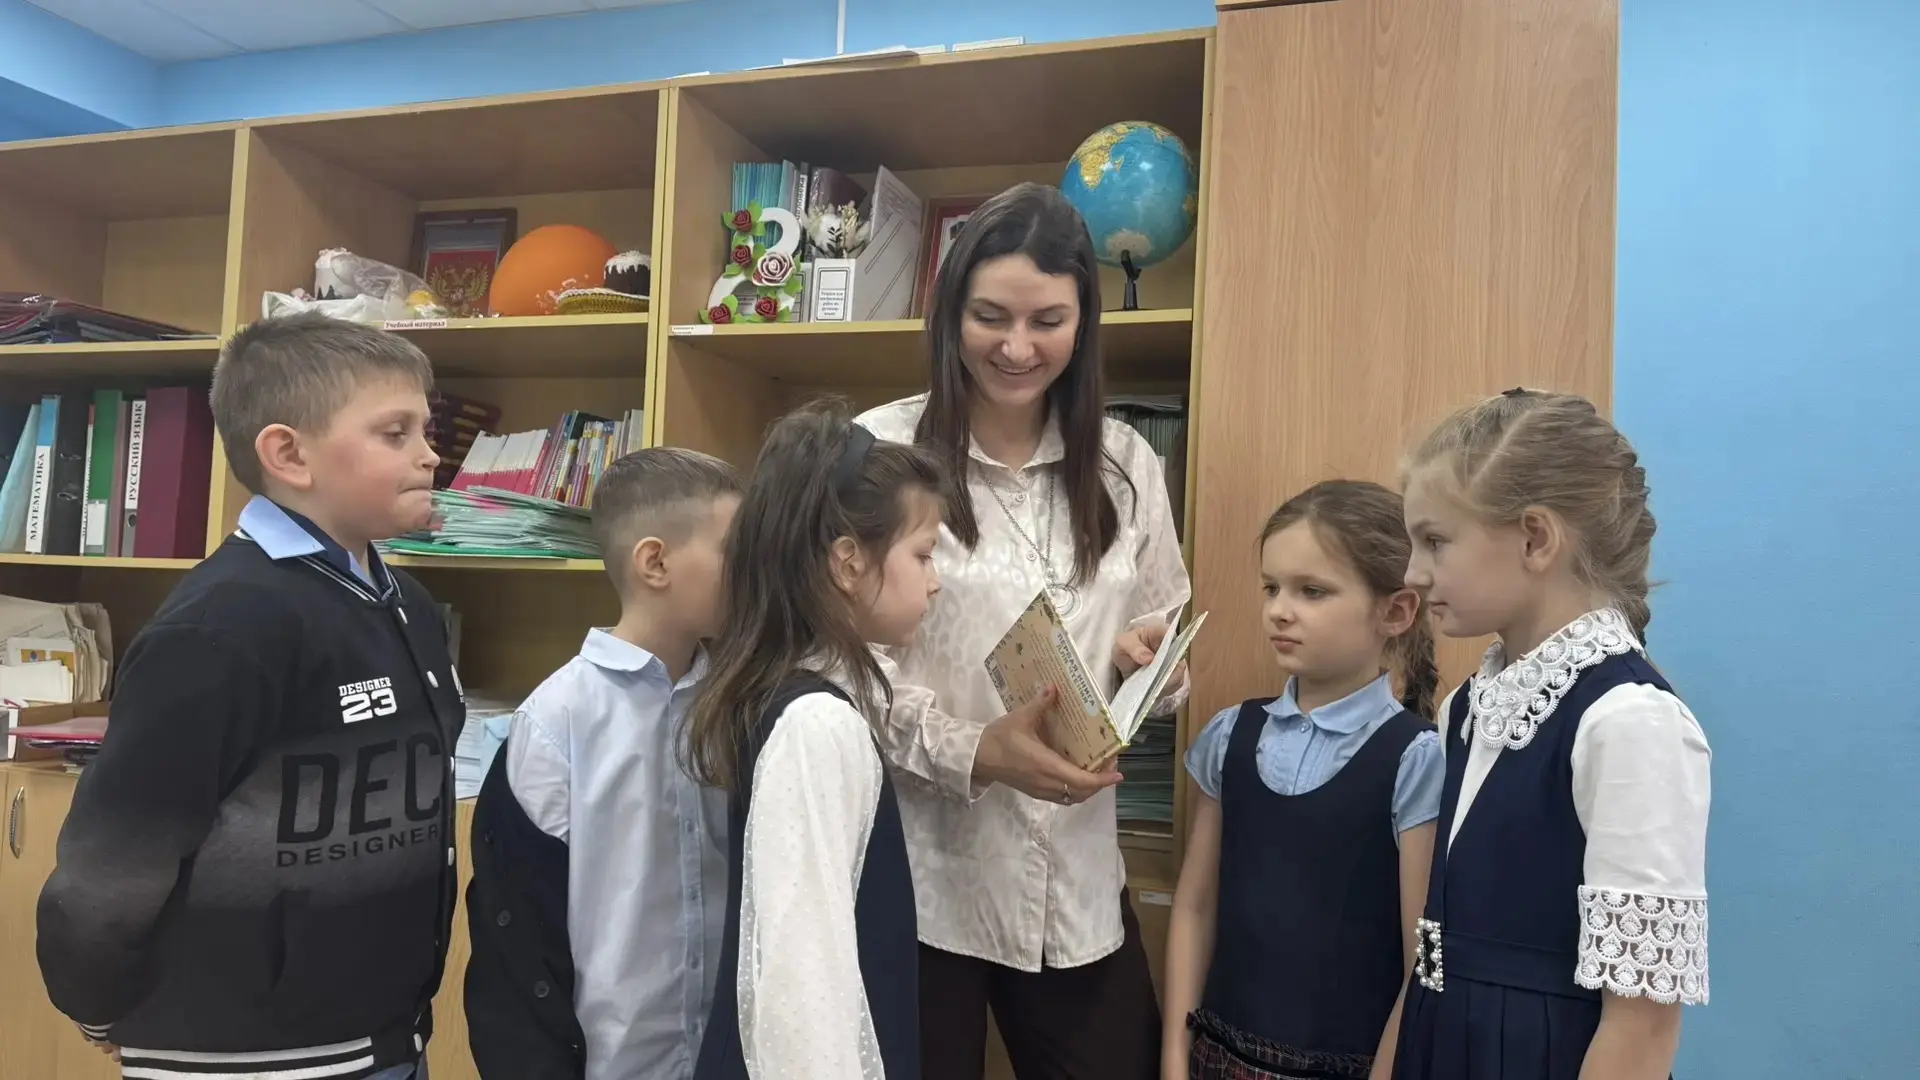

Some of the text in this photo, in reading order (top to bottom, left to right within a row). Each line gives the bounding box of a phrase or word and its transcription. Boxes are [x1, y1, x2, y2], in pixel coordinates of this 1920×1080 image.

[128, 403, 143, 500] РУССКИЙ ЯЗЫК
[30, 453, 45, 540] МАТЕМАТИКА
[338, 676, 392, 697] DESIGNER
[340, 687, 397, 724] 23
[276, 732, 441, 844] DEC
[276, 824, 438, 868] DESIGNER
